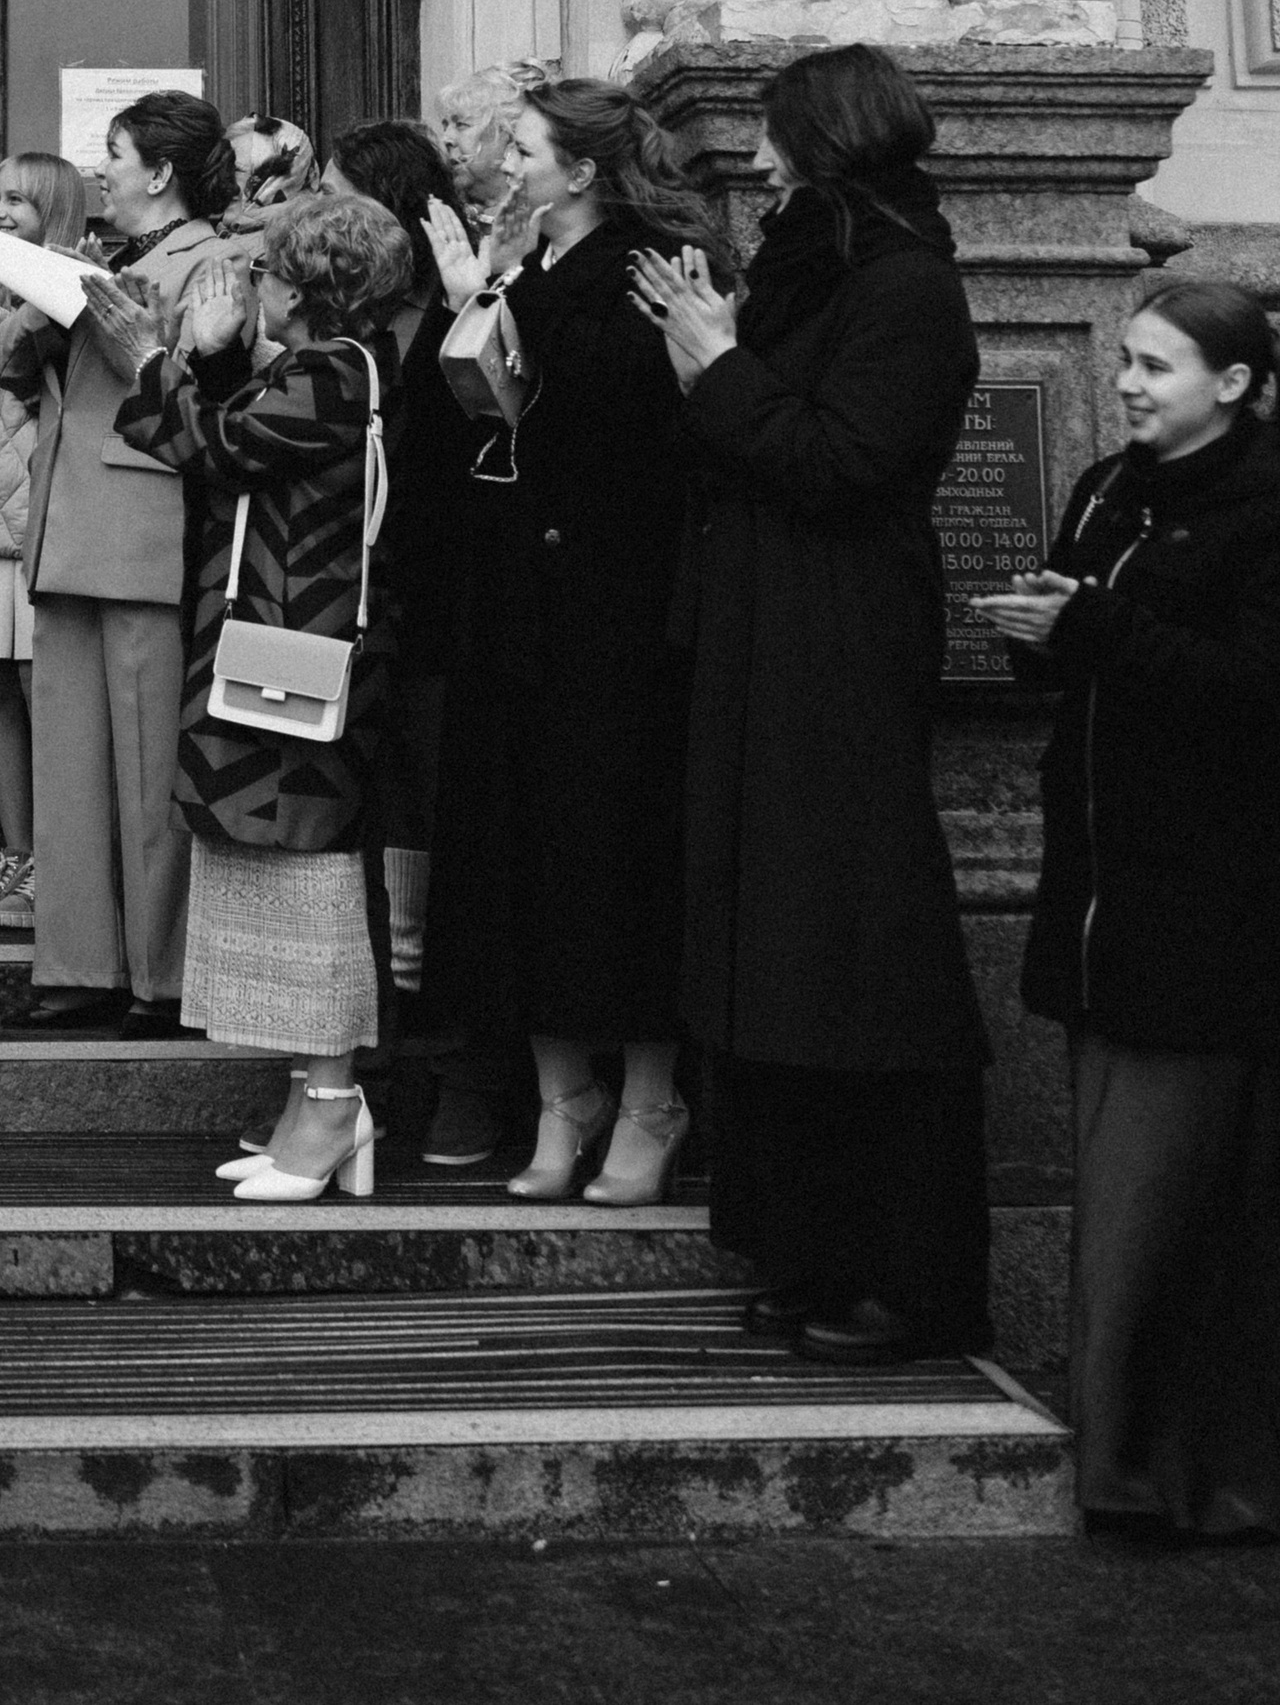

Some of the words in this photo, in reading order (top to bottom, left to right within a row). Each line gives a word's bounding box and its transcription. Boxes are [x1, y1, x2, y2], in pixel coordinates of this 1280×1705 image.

[964, 414, 996, 430] ТЫ:
[955, 439, 1014, 450] ЯВЛЕНИЙ
[951, 453, 982, 462] НИИ
[986, 453, 1025, 462] БРАКА
[940, 468, 1005, 482] -20.00
[949, 505, 1011, 515] ГРАЖДАН
[931, 517, 974, 527] НИКОМ
[979, 517, 1027, 527] ОТДЕЛА
[945, 593, 969, 603] ТОВ
[948, 640, 989, 650] РЕРЫВ
